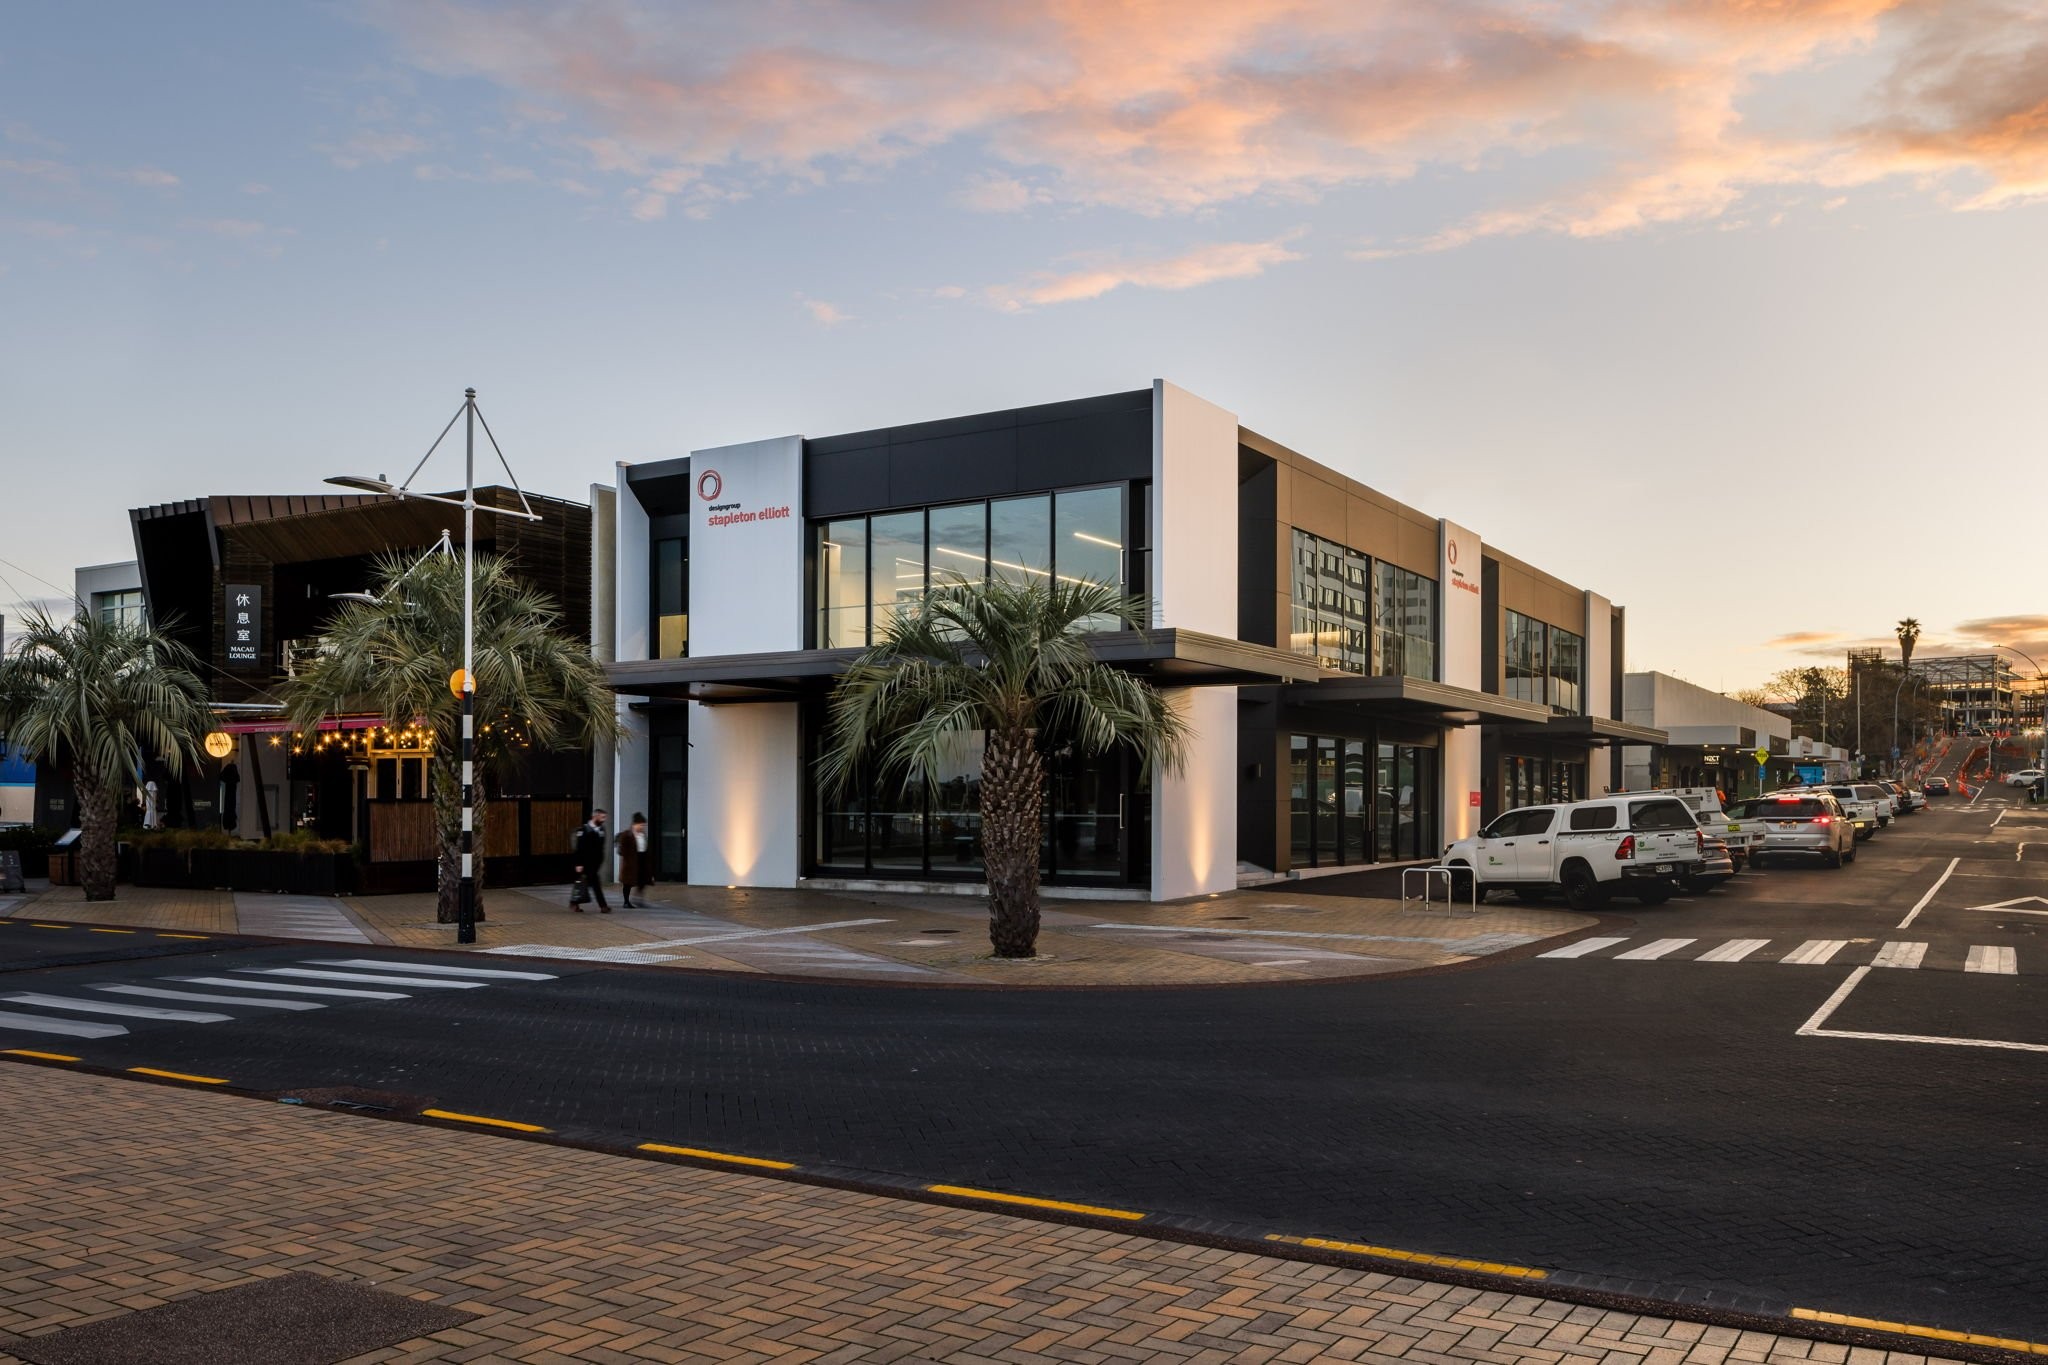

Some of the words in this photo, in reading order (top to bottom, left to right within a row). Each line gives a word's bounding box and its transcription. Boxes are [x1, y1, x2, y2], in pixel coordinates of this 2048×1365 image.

[708, 511, 756, 527] stapleton
[758, 506, 790, 520] elliott
[236, 593, 250, 641] 休息室
